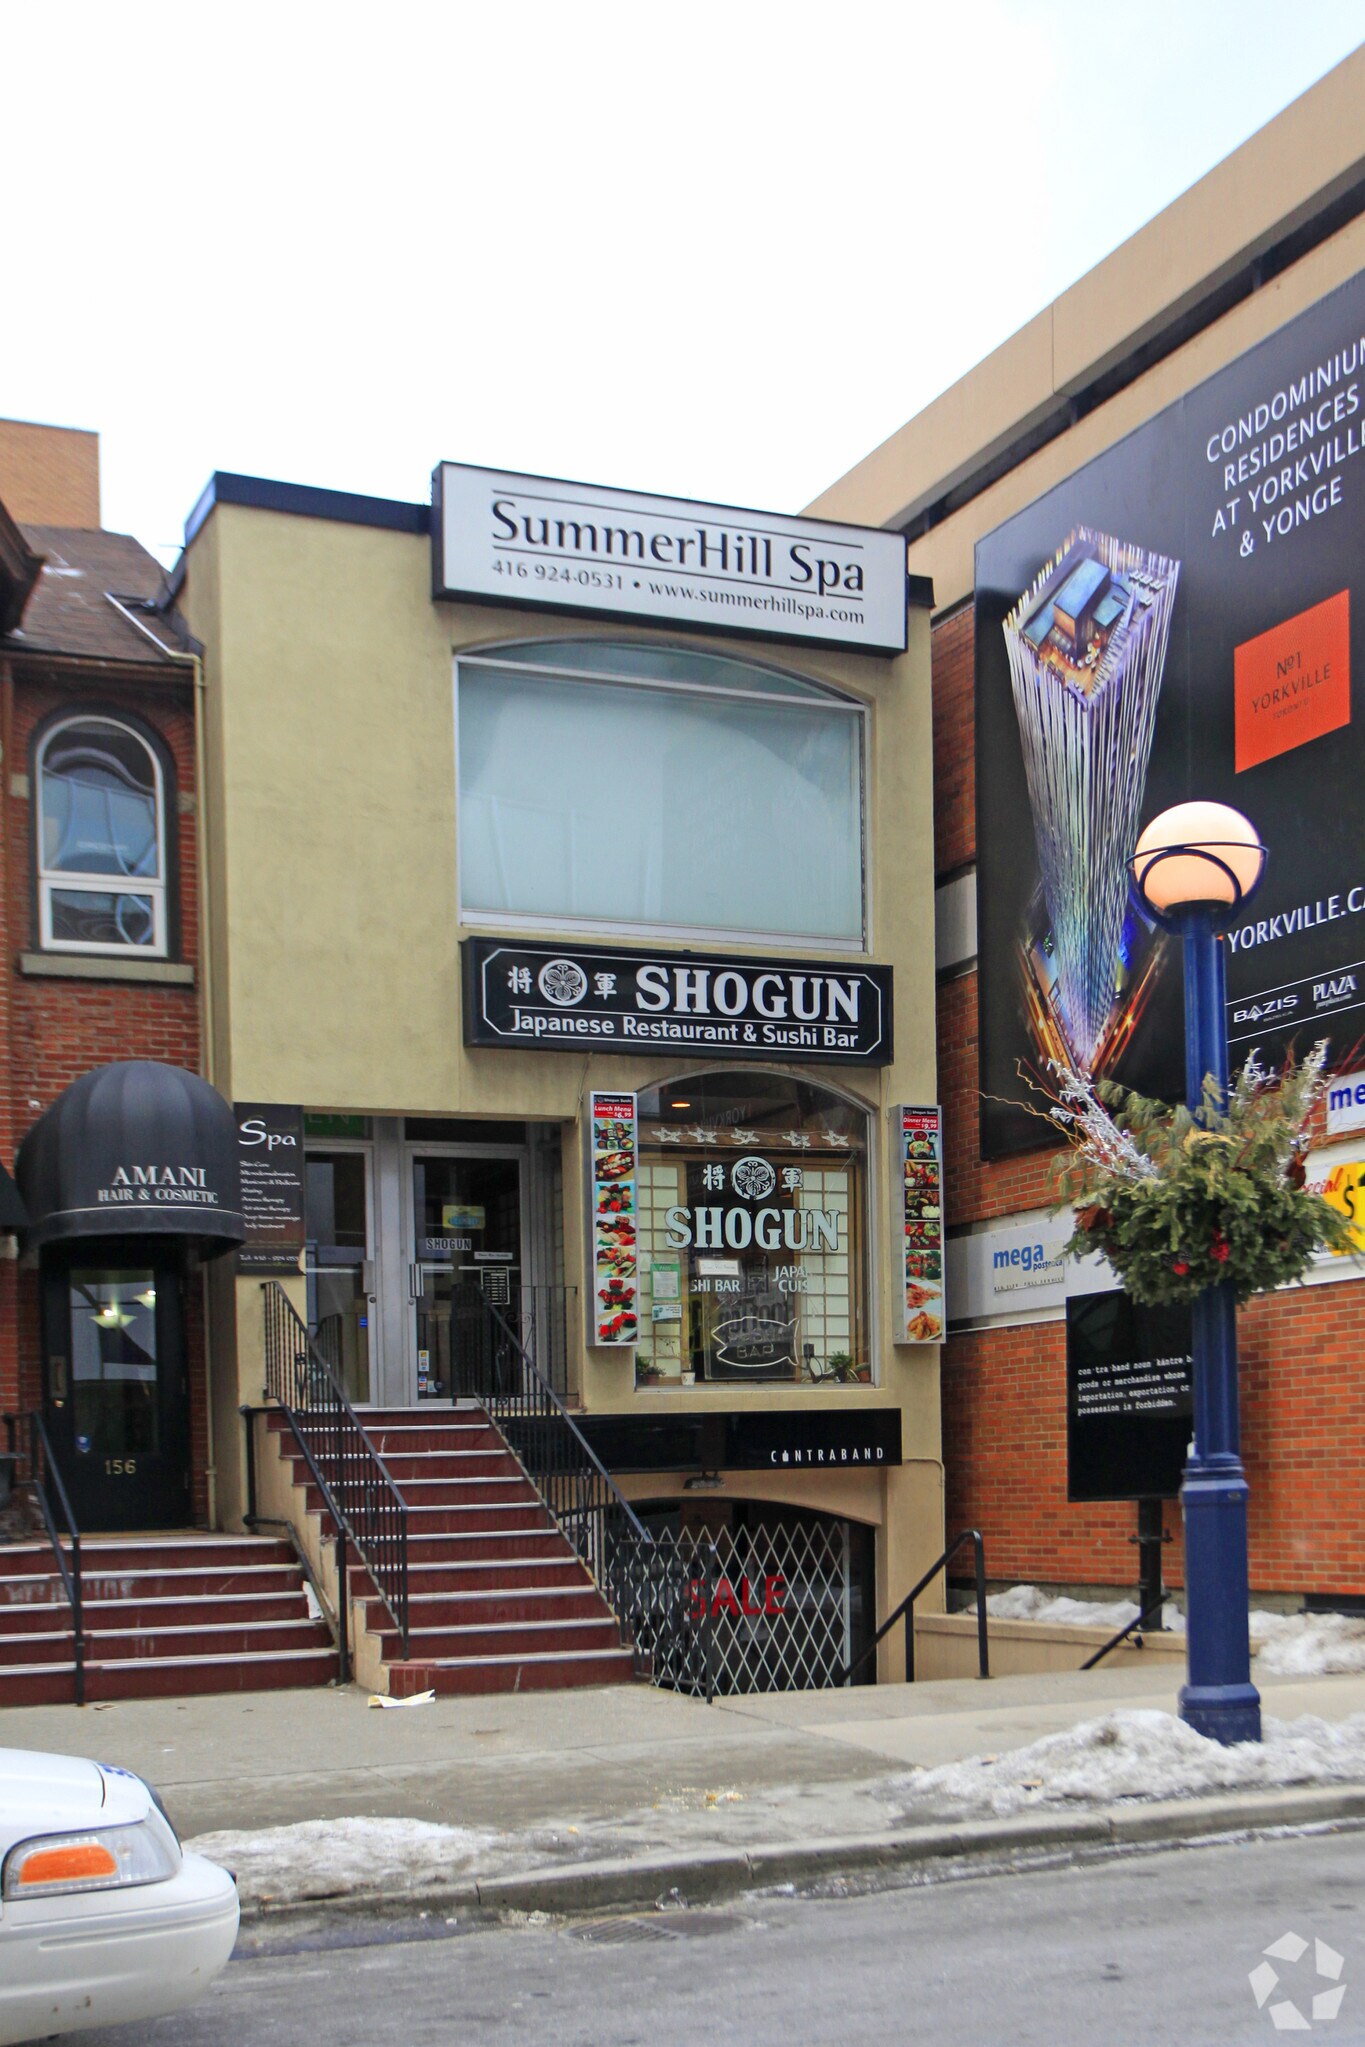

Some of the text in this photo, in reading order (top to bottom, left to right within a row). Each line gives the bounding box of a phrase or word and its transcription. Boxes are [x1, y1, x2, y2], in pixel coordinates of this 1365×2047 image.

[1224, 383, 1359, 491] RESIDENCES
[1212, 497, 1241, 538] AT
[1239, 475, 1342, 558] & YONGE
[492, 500, 864, 596] SummerHill Spa
[492, 559, 865, 625] 416 924-0531 www.summerhillspa.com
[1251, 663, 1332, 714] YORKVILLE
[1227, 886, 1365, 953] YORKVILLE.C
[635, 965, 861, 1023] SHOGUN
[1313, 975, 1357, 1001] PLAZA
[1233, 995, 1299, 1023] BAZIS
[511, 1009, 859, 1048] Japanese Restaurant & Sushi Bar
[238, 1119, 297, 1151] Spa
[111, 1165, 207, 1188] AMANI
[98, 1188, 218, 1204] HAIR & COSMETIC
[426, 1238, 471, 1250] SHOGUN
[664, 1205, 841, 1251] SHOGUN
[771, 1265, 808, 1282] JAPA
[993, 1244, 1044, 1271] mega
[715, 1279, 741, 1292] BAR
[1077, 1380, 1099, 1391] goods
[1114, 1373, 1161, 1386] merchandise
[1164, 1371, 1186, 1380] whose
[1123, 1403, 1132, 1411] is
[104, 1459, 137, 1475] 156
[685, 1574, 786, 1620] SALE
